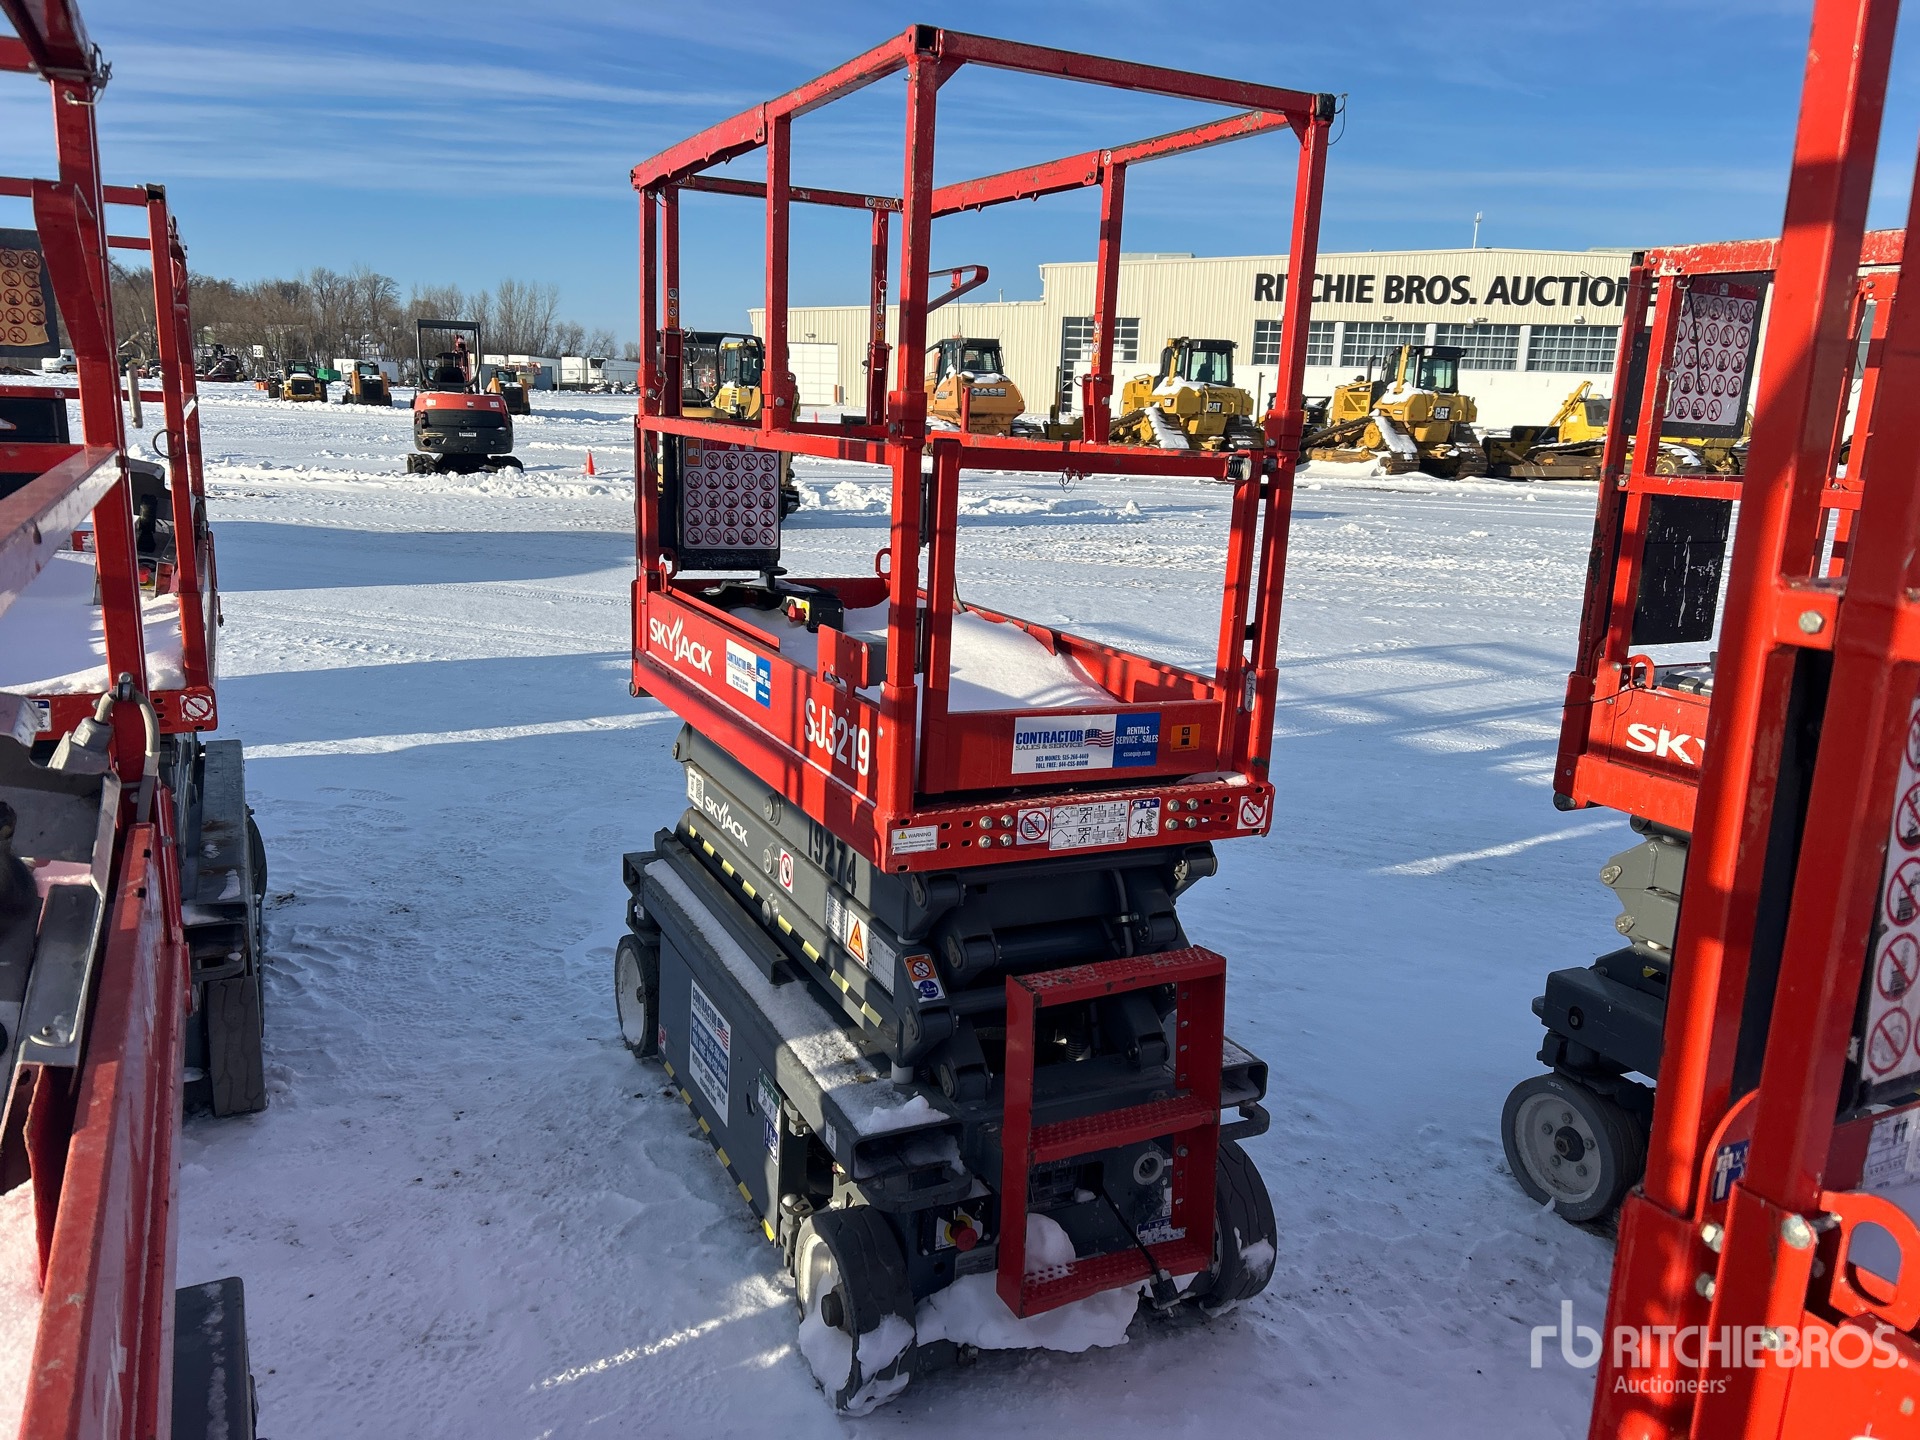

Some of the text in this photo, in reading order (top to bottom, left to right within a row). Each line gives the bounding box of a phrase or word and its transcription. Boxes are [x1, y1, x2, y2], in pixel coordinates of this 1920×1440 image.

[1254, 273, 1375, 303] RIHIE
[1383, 274, 1478, 305] BROS.
[971, 388, 1006, 396] CASE
[1208, 402, 1221, 413] CAT
[1435, 407, 1450, 420] CAT
[649, 616, 713, 676] SKYJACK
[804, 698, 870, 776] SJ3219
[1016, 730, 1084, 744] CONTRACTOR
[1115, 736, 1138, 745] SERVICE
[1142, 734, 1159, 744] SALES
[1126, 726, 1150, 735] RENTALS
[1625, 722, 1706, 766] SK
[705, 795, 748, 847] SKYJACK
[808, 818, 857, 896] 19274
